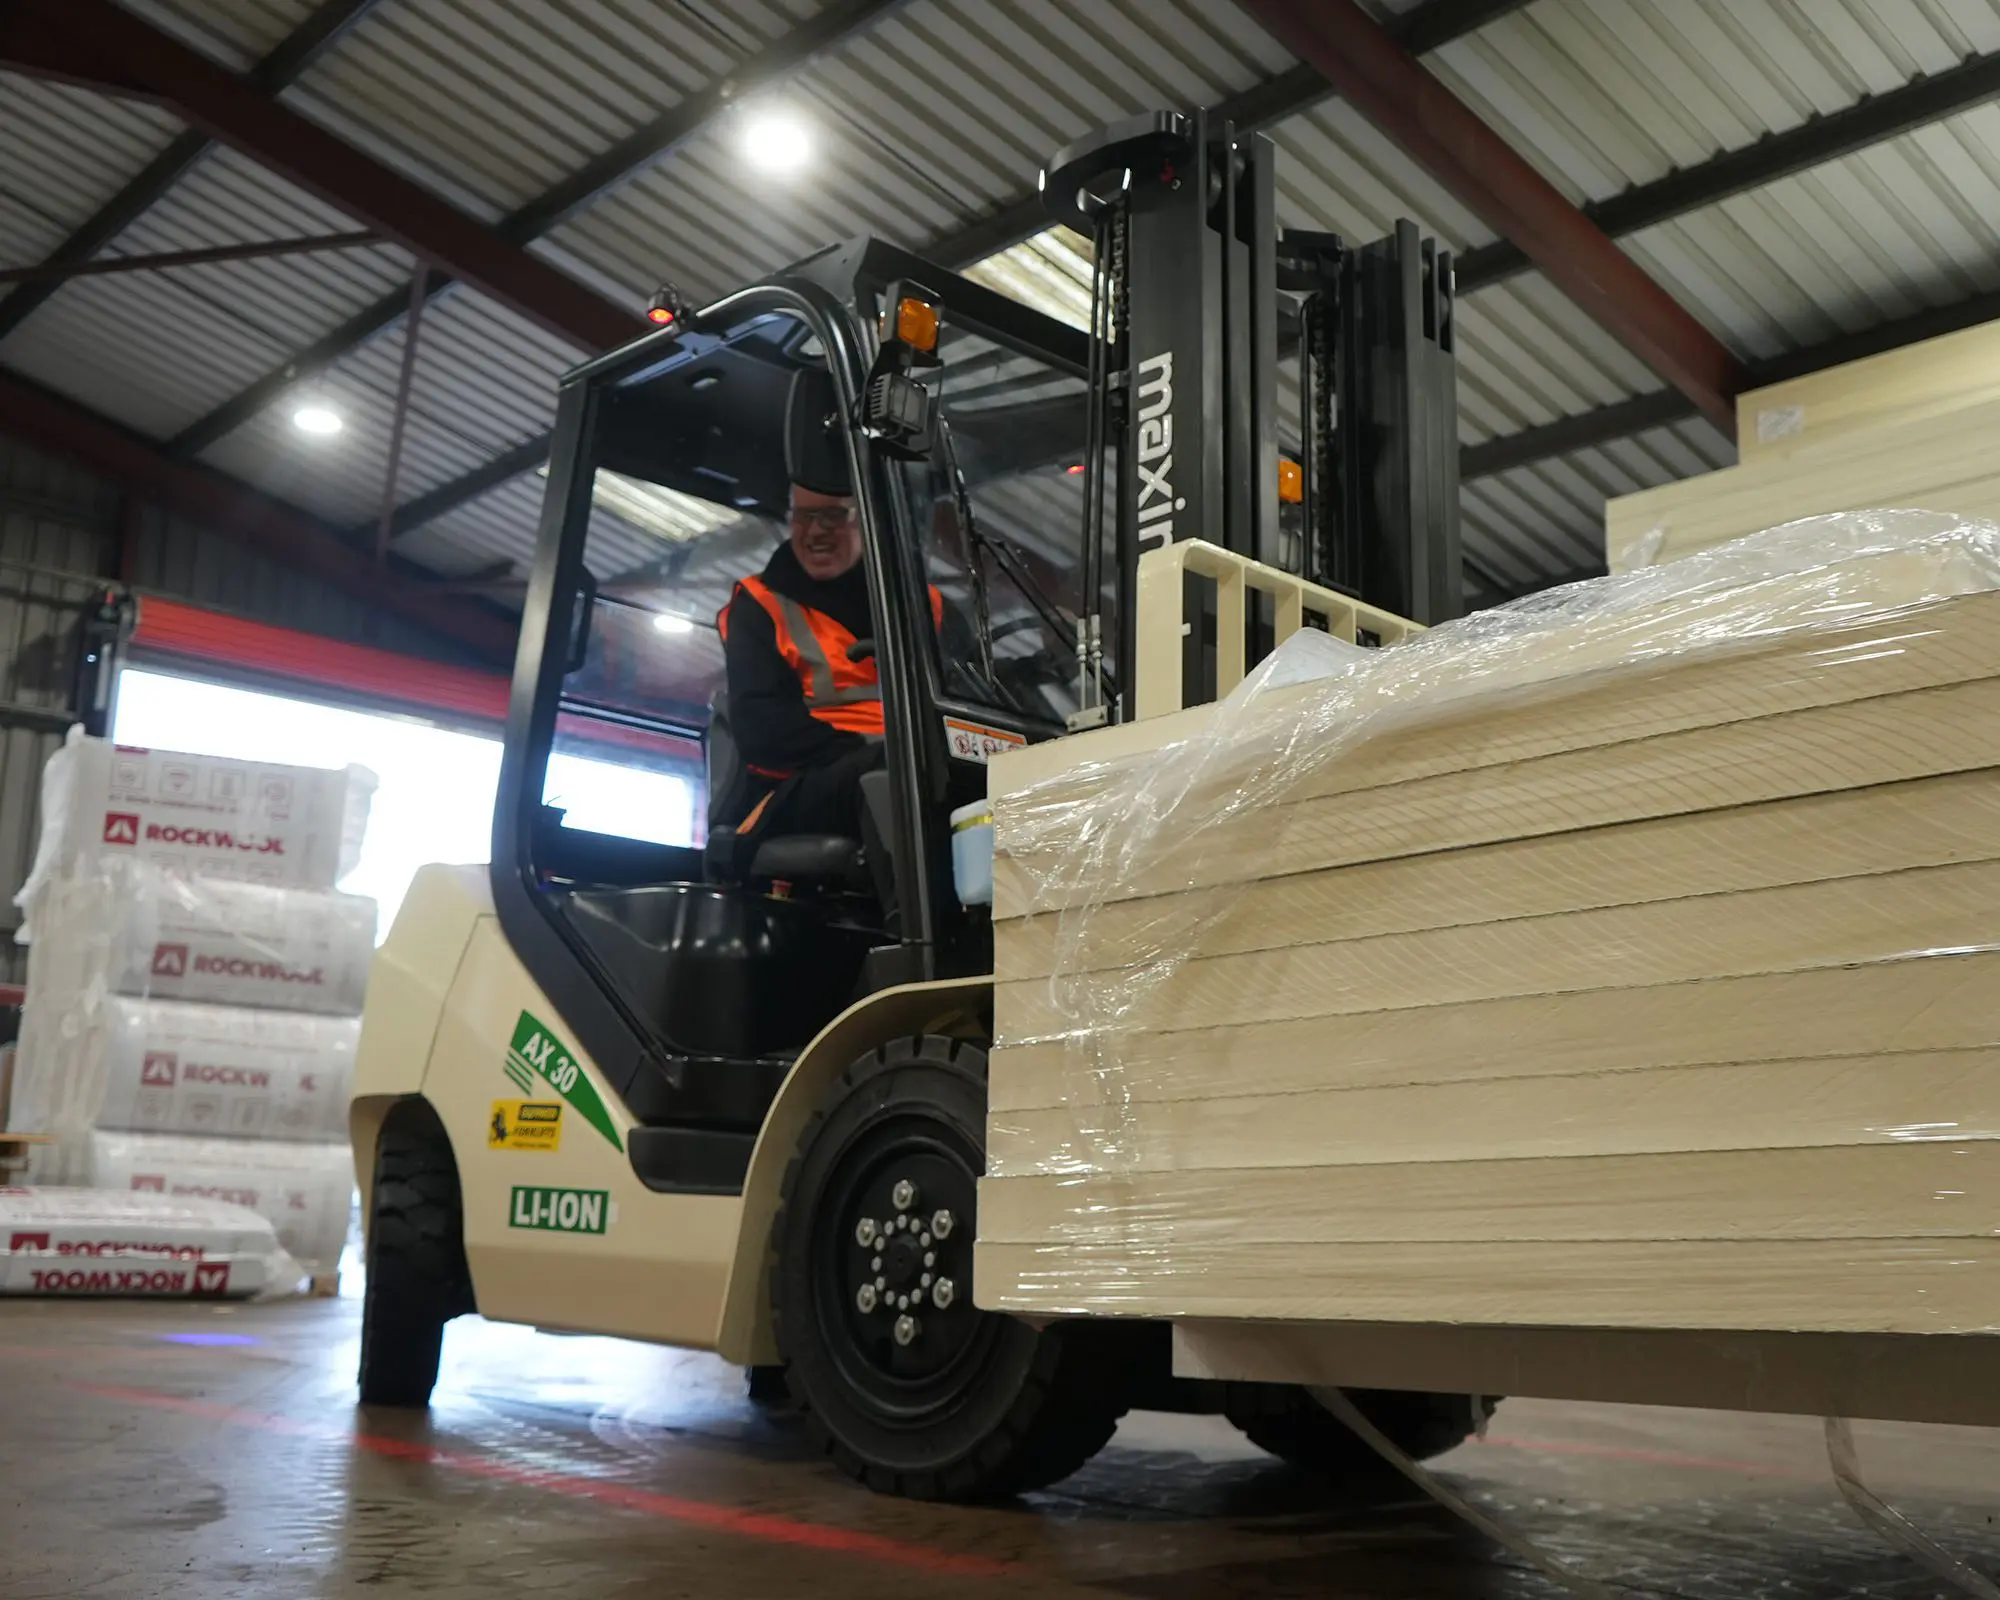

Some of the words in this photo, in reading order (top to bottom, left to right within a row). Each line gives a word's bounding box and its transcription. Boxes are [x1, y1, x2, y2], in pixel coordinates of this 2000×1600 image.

[183, 1064, 317, 1092] ROCKWL
[522, 1032, 555, 1072] AX
[550, 1056, 579, 1093] 30
[514, 1190, 602, 1231] LI-ION
[31, 1269, 187, 1292] ROCKWOOL
